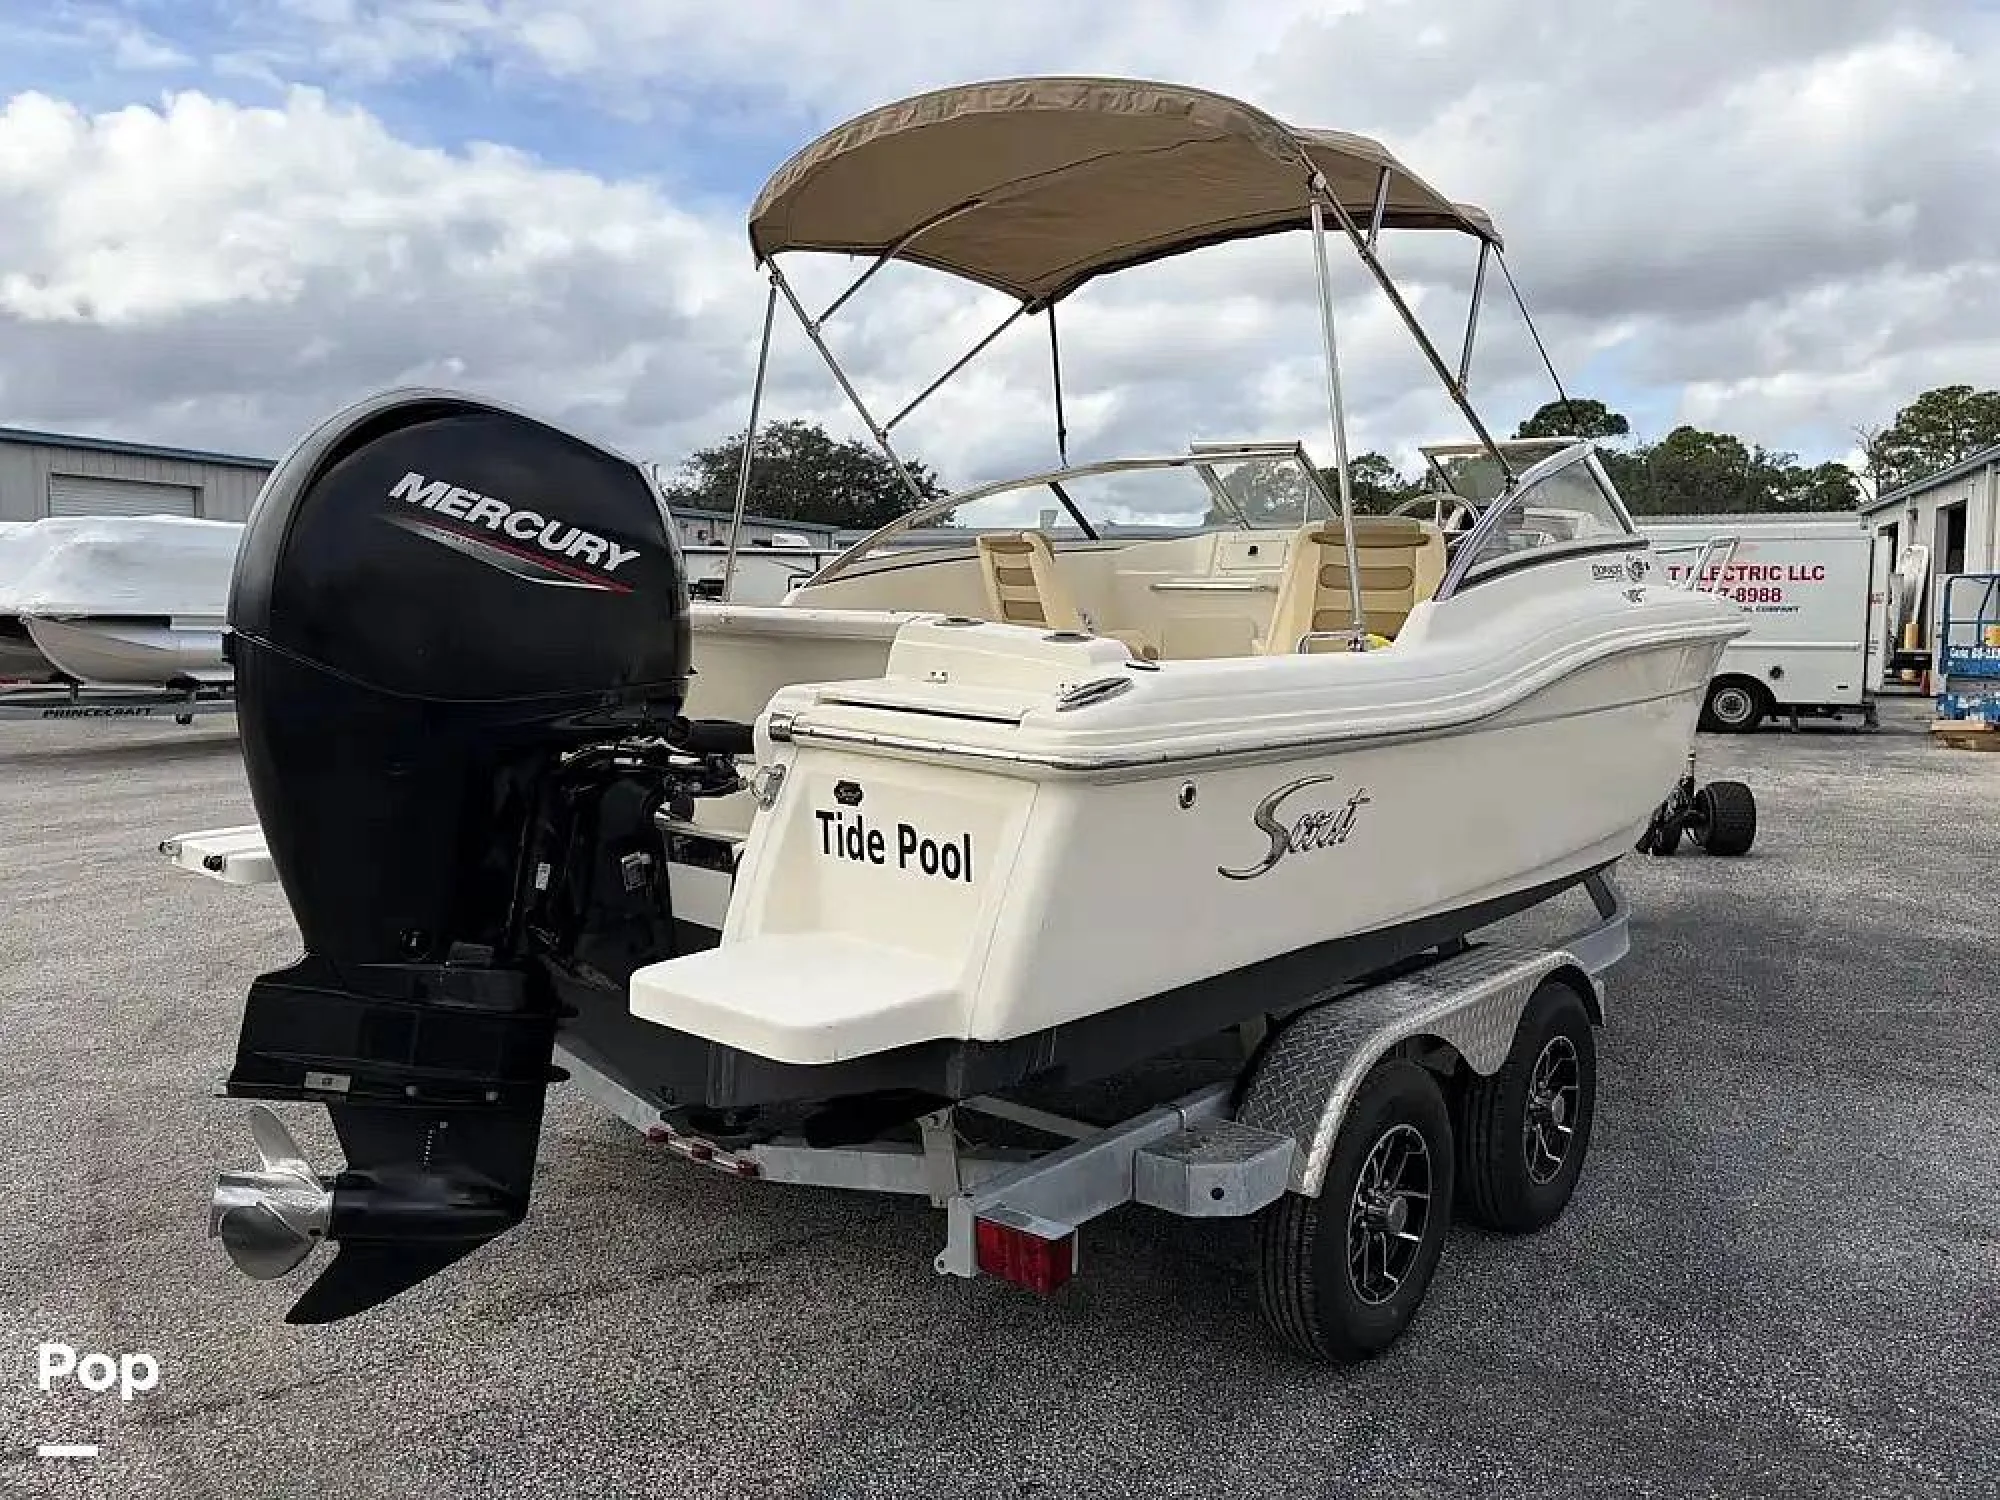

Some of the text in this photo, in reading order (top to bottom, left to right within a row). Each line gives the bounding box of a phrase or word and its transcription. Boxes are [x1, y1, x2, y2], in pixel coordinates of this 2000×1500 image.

[388, 472, 641, 571] MERCURY
[1696, 587, 1782, 603] 7-8988
[1788, 565, 1825, 581] LLC
[42, 707, 154, 718] PRINCECRAFT
[816, 810, 973, 883] Tide Pool
[1217, 774, 1371, 881] Scout
